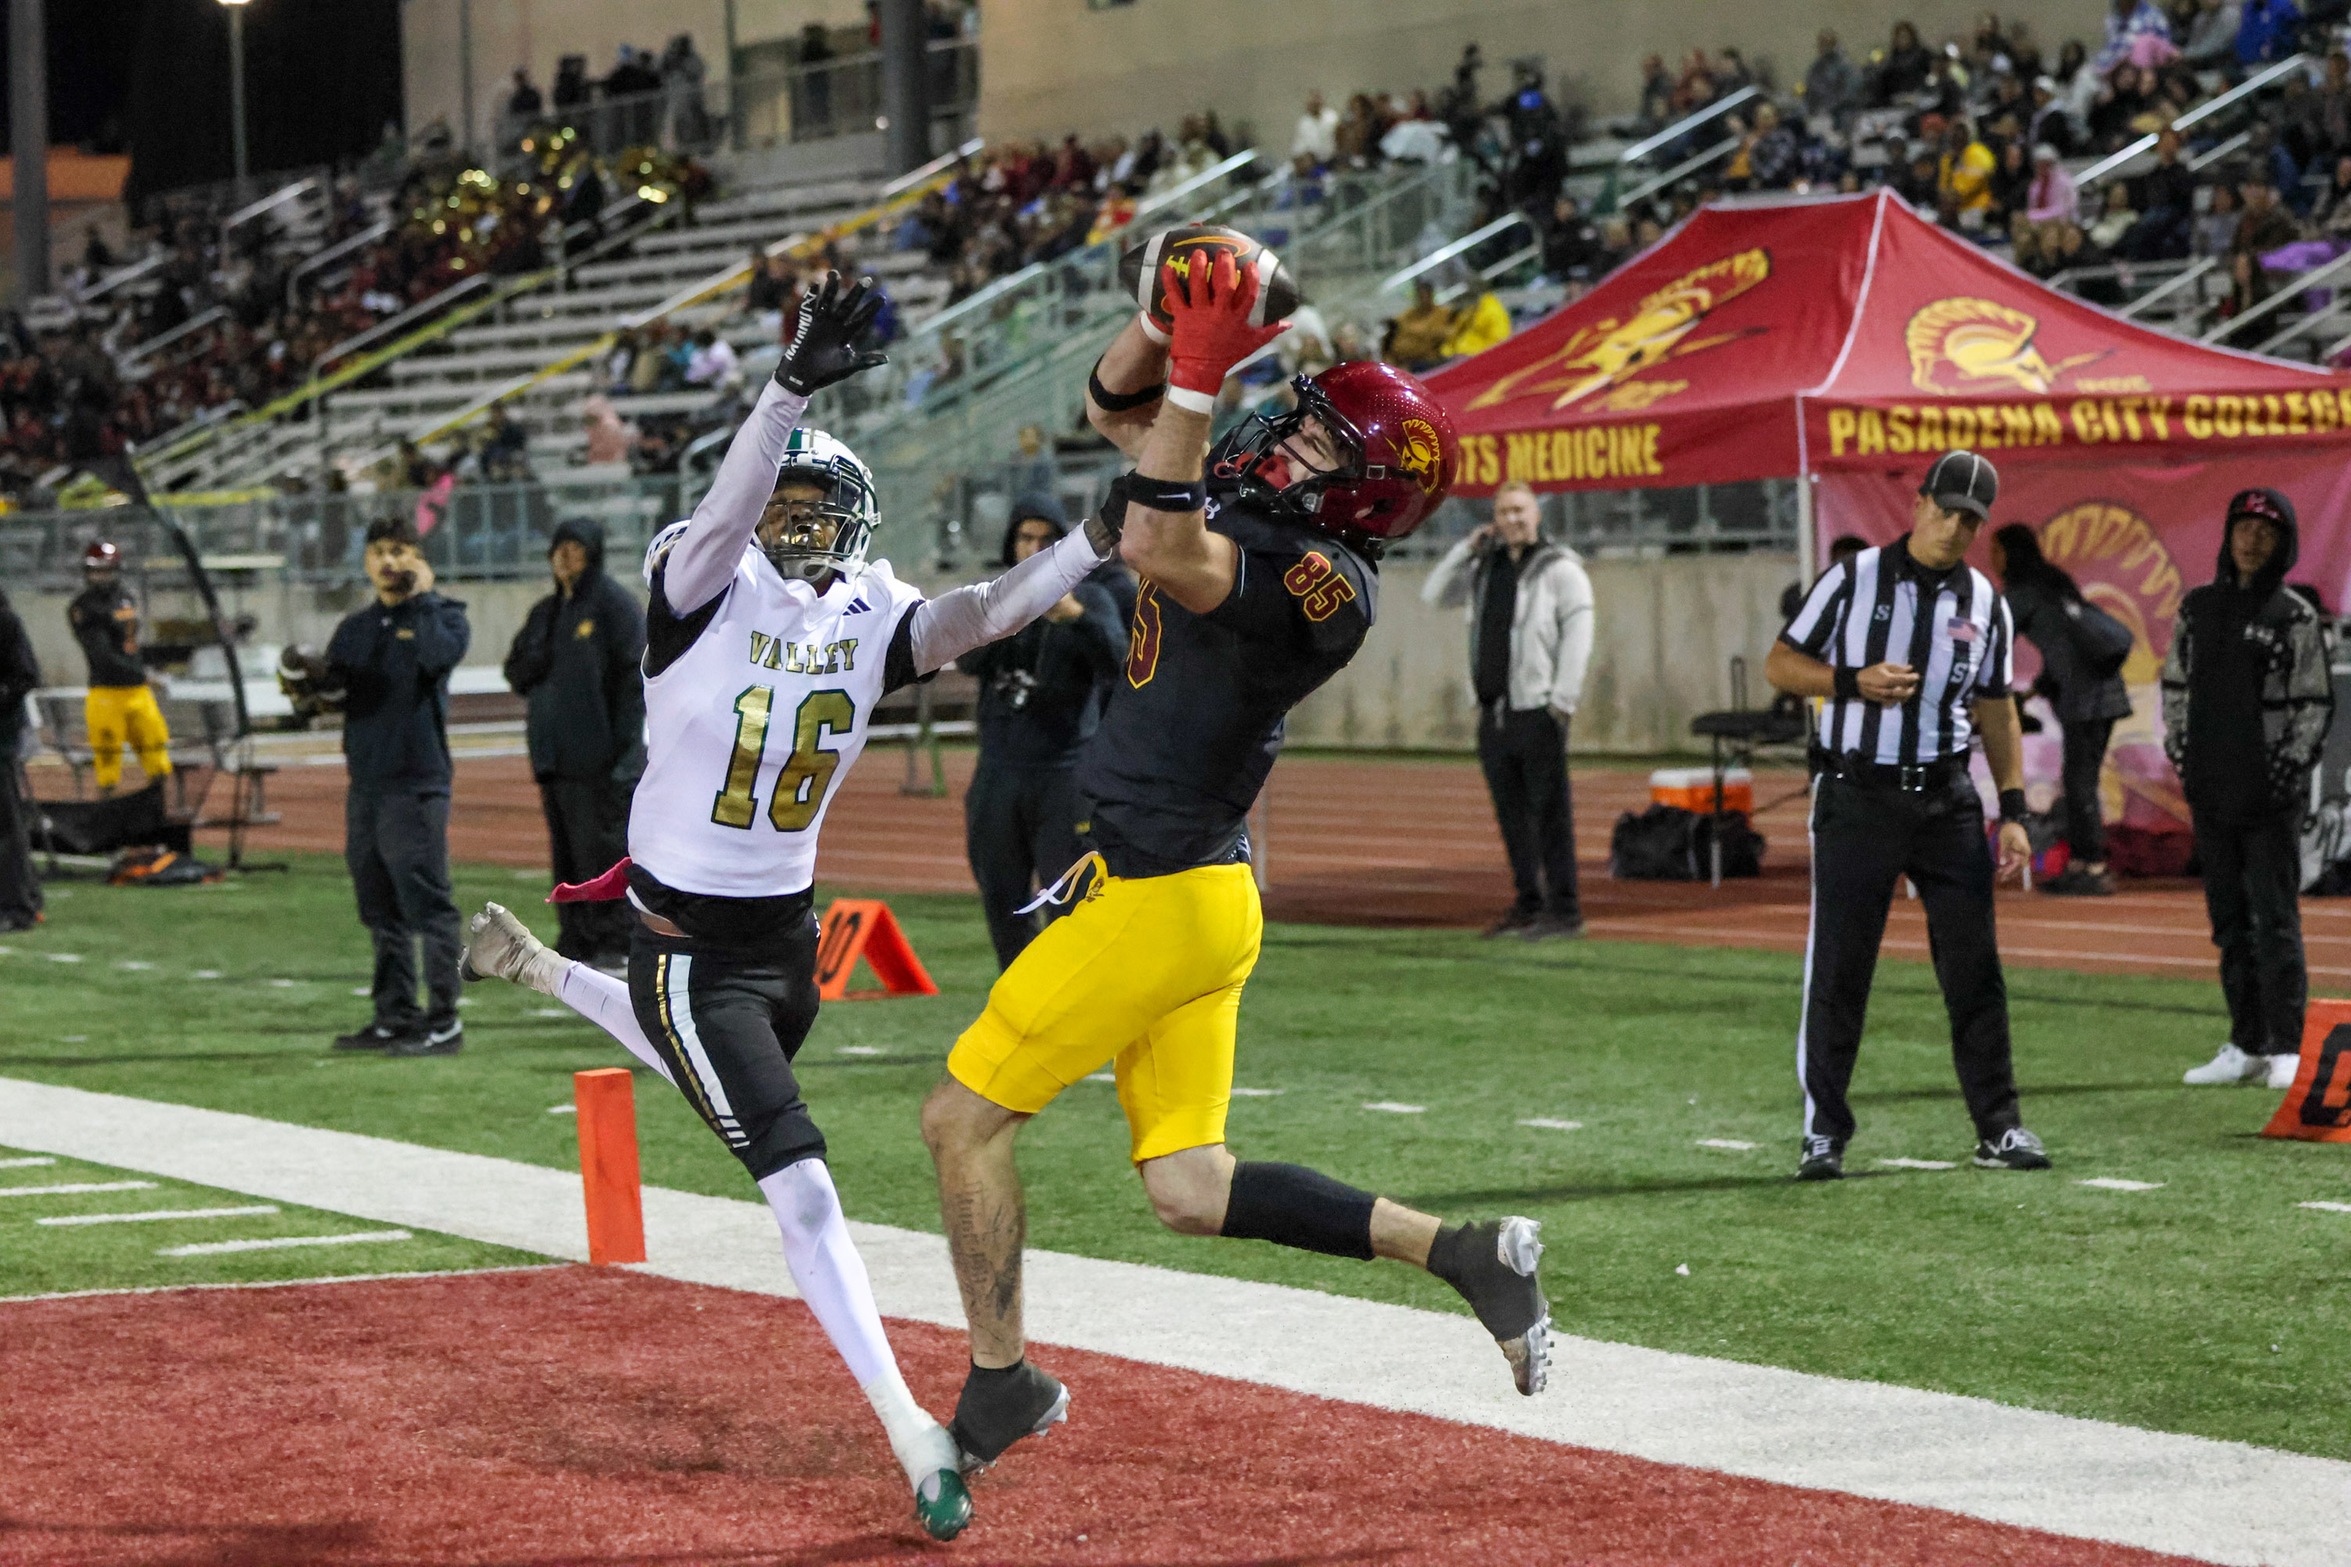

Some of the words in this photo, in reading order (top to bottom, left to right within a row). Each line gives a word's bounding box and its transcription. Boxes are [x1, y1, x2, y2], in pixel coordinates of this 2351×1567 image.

[1455, 434, 1500, 486] TS
[1507, 424, 1664, 483] MEDICINE
[1828, 404, 2063, 457] PASADENA
[2069, 396, 2172, 444] CITY
[1284, 551, 1357, 622] 85
[1873, 603, 1892, 622] S
[749, 630, 859, 675] VALLEY
[710, 683, 857, 833] 16
